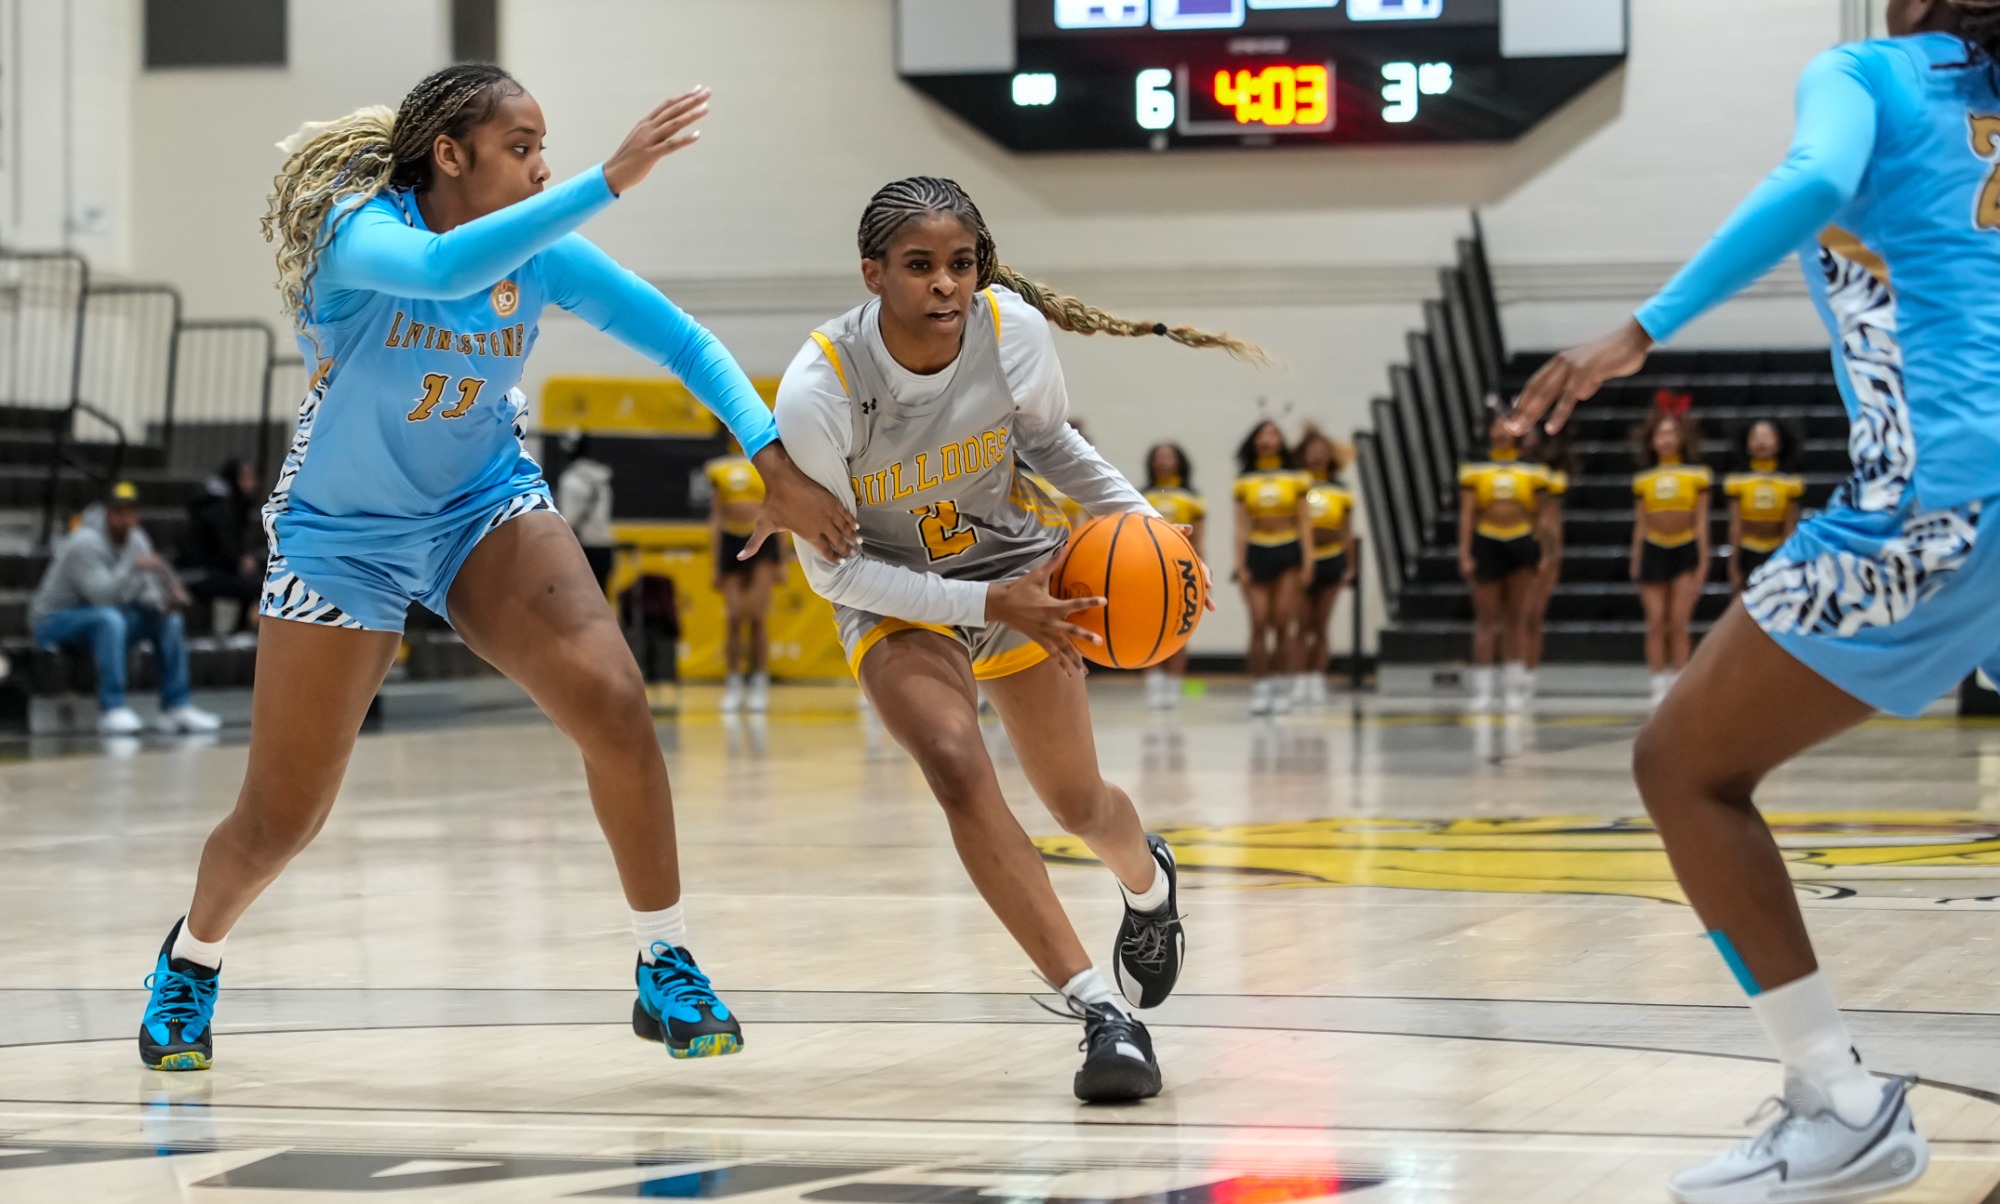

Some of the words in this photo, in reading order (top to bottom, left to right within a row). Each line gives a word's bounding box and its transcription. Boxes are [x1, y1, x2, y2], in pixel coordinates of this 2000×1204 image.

[1136, 68, 1175, 129] 6
[1214, 64, 1328, 126] 4:03
[1381, 61, 1418, 123] 3
[407, 373, 487, 422] 11
[909, 500, 979, 564] 2
[1177, 559, 1198, 636] NCAA
